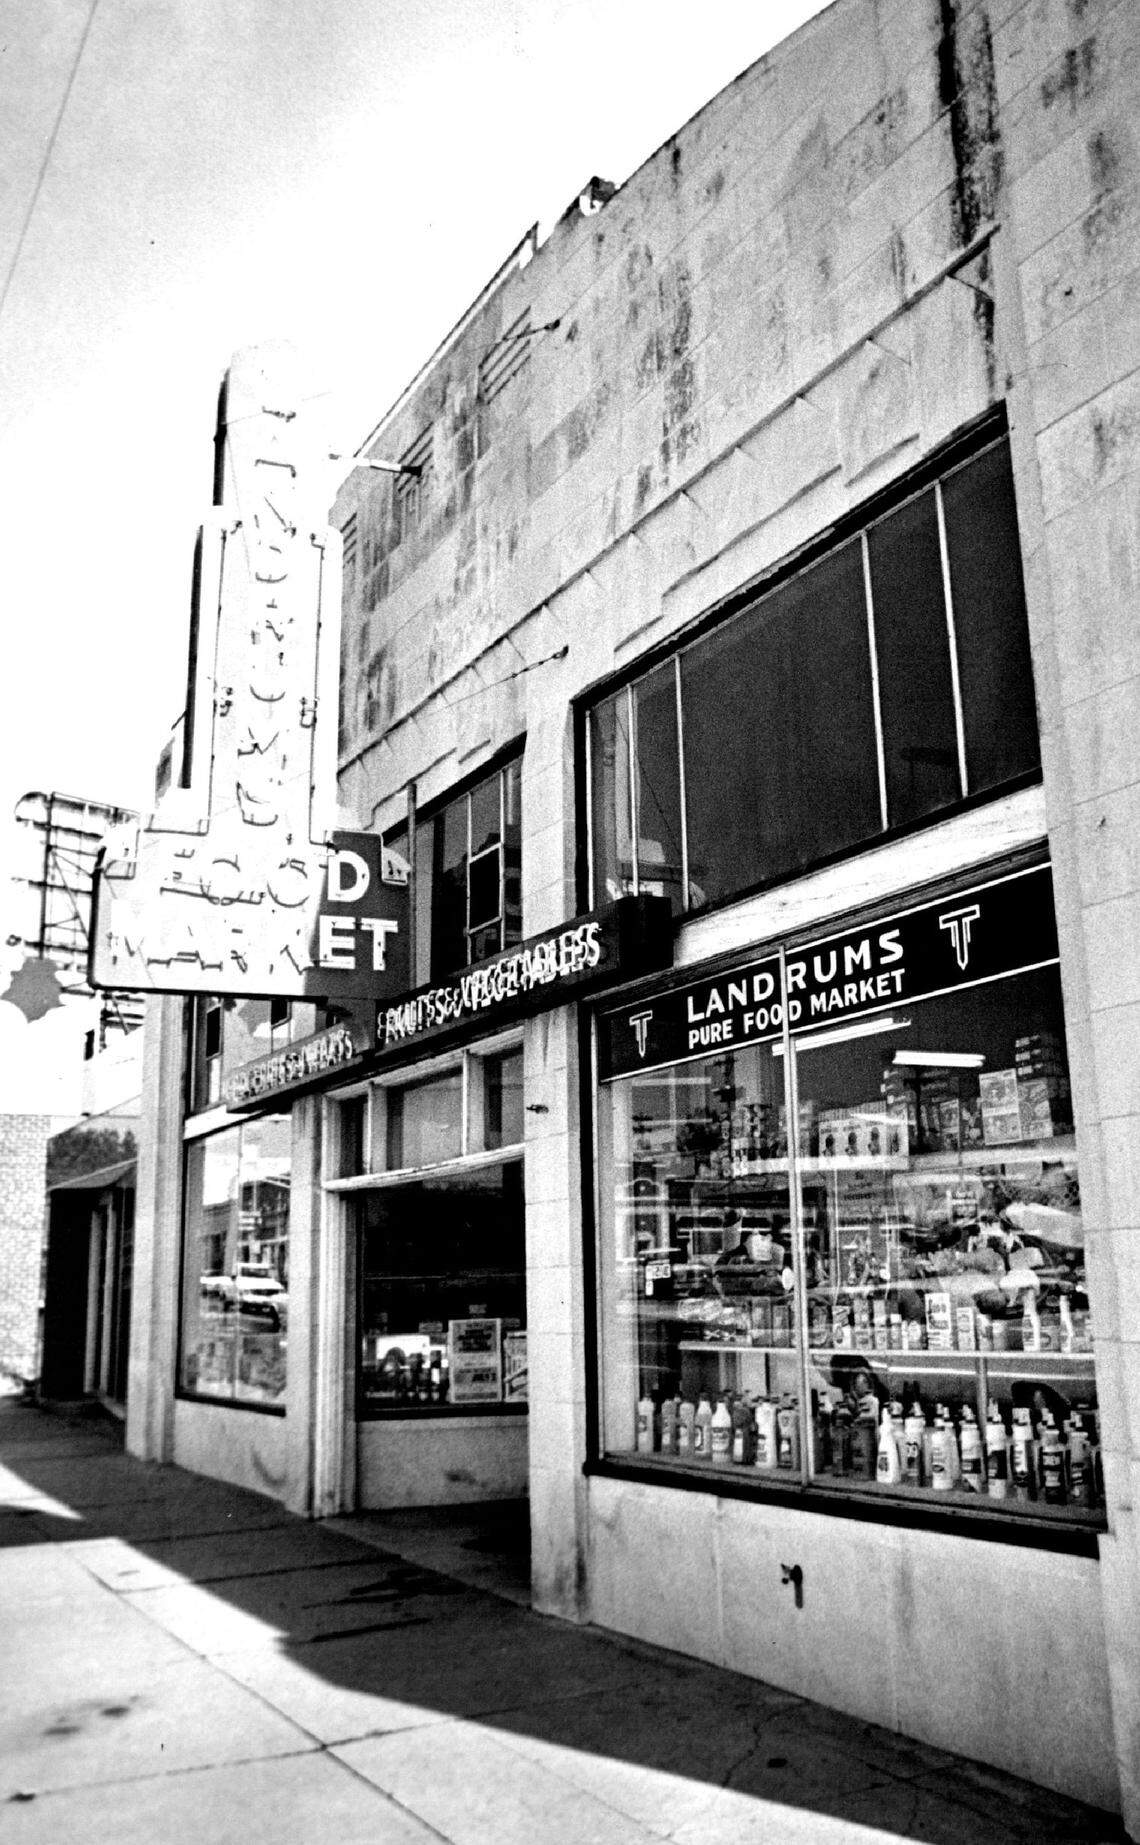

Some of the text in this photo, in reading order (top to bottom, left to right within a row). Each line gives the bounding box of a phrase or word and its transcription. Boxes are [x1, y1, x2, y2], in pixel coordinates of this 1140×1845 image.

[686, 929, 904, 1023] LANDRUMS
[688, 969, 905, 1050] PURE FOOD MARKET
